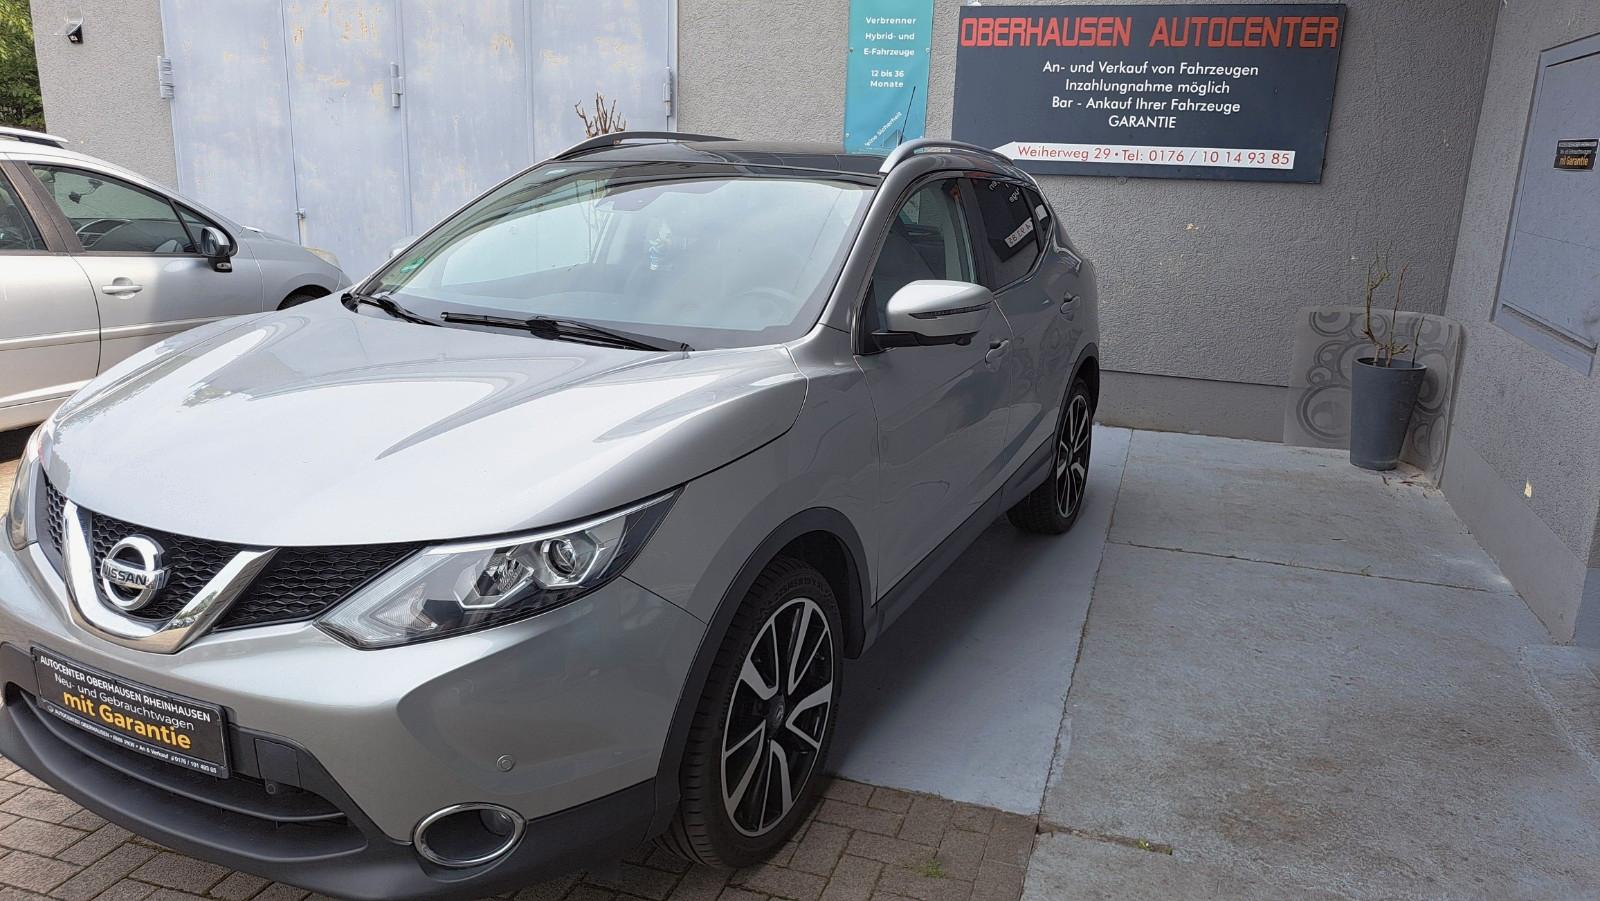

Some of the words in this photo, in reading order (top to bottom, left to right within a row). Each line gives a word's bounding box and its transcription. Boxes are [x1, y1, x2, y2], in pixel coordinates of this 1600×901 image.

[865, 16, 917, 25] Verbrenner
[865, 32, 897, 42] Hybrid-
[898, 32, 915, 41] und
[960, 16, 1132, 47] OBERHAUSEN
[1148, 16, 1339, 48] AUTOCENTER
[863, 47, 915, 57] E-Fahrzeuge
[880, 70, 893, 78] bis
[894, 70, 905, 78] 36
[1042, 61, 1066, 73] An-
[1070, 60, 1094, 73] und
[1099, 60, 1149, 74] Verkauf
[1151, 64, 1175, 75] von
[1179, 62, 1259, 79] Fahrzeugen
[870, 80, 904, 88] Monate
[1065, 78, 1173, 95] Inzahlungnahme
[1177, 80, 1230, 96] möglich
[1052, 96, 1073, 108] Bar
[1085, 97, 1132, 110] Ankauf
[1136, 97, 1167, 110] Ihrer
[1170, 98, 1241, 115] Fahrzeuge
[1108, 115, 1177, 128] GARANTIE
[1018, 145, 1089, 161] Weiherweg
[1094, 147, 1112, 159] 29
[1122, 149, 1143, 161] Tel:
[1149, 150, 1185, 162] 0176
[1203, 151, 1219, 163] 10
[1226, 151, 1242, 163] 14
[1248, 152, 1266, 164] 93
[1271, 153, 1290, 165] 85
[104, 564, 148, 586] NISSAN
[40, 655, 86, 682] AUTOCENTER
[86, 675, 141, 702] OBERHAUSEN
[143, 695, 211, 723] RHEINHAUSEN
[54, 672, 75, 688] Neu-
[77, 685, 97, 698] und
[99, 692, 195, 731] Gebrauchtwagen
[63, 691, 96, 717] mit
[99, 704, 191, 749] Garantie
